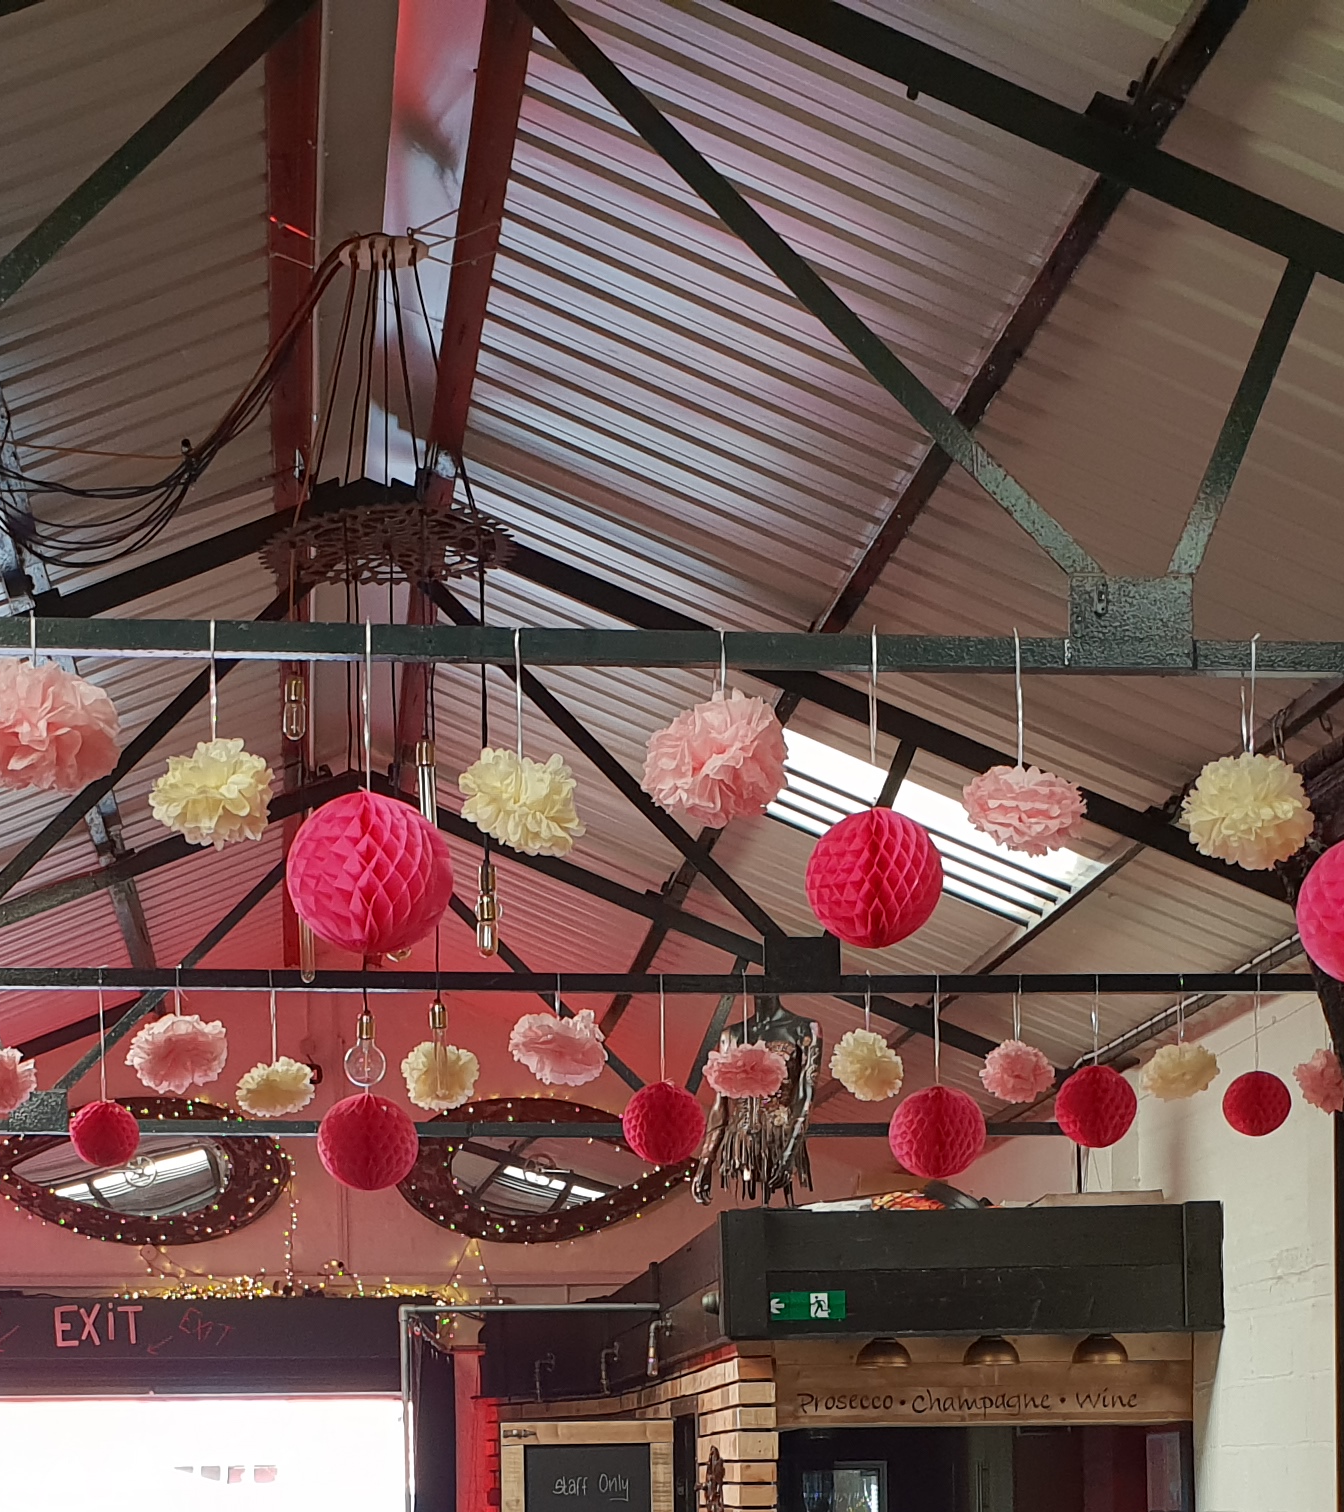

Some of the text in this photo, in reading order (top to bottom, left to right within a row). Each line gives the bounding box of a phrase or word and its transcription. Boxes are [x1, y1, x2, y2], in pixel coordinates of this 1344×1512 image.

[796, 1387, 1139, 1417] Prosecco Champagne Wine
[598, 1472, 630, 1502] Only
